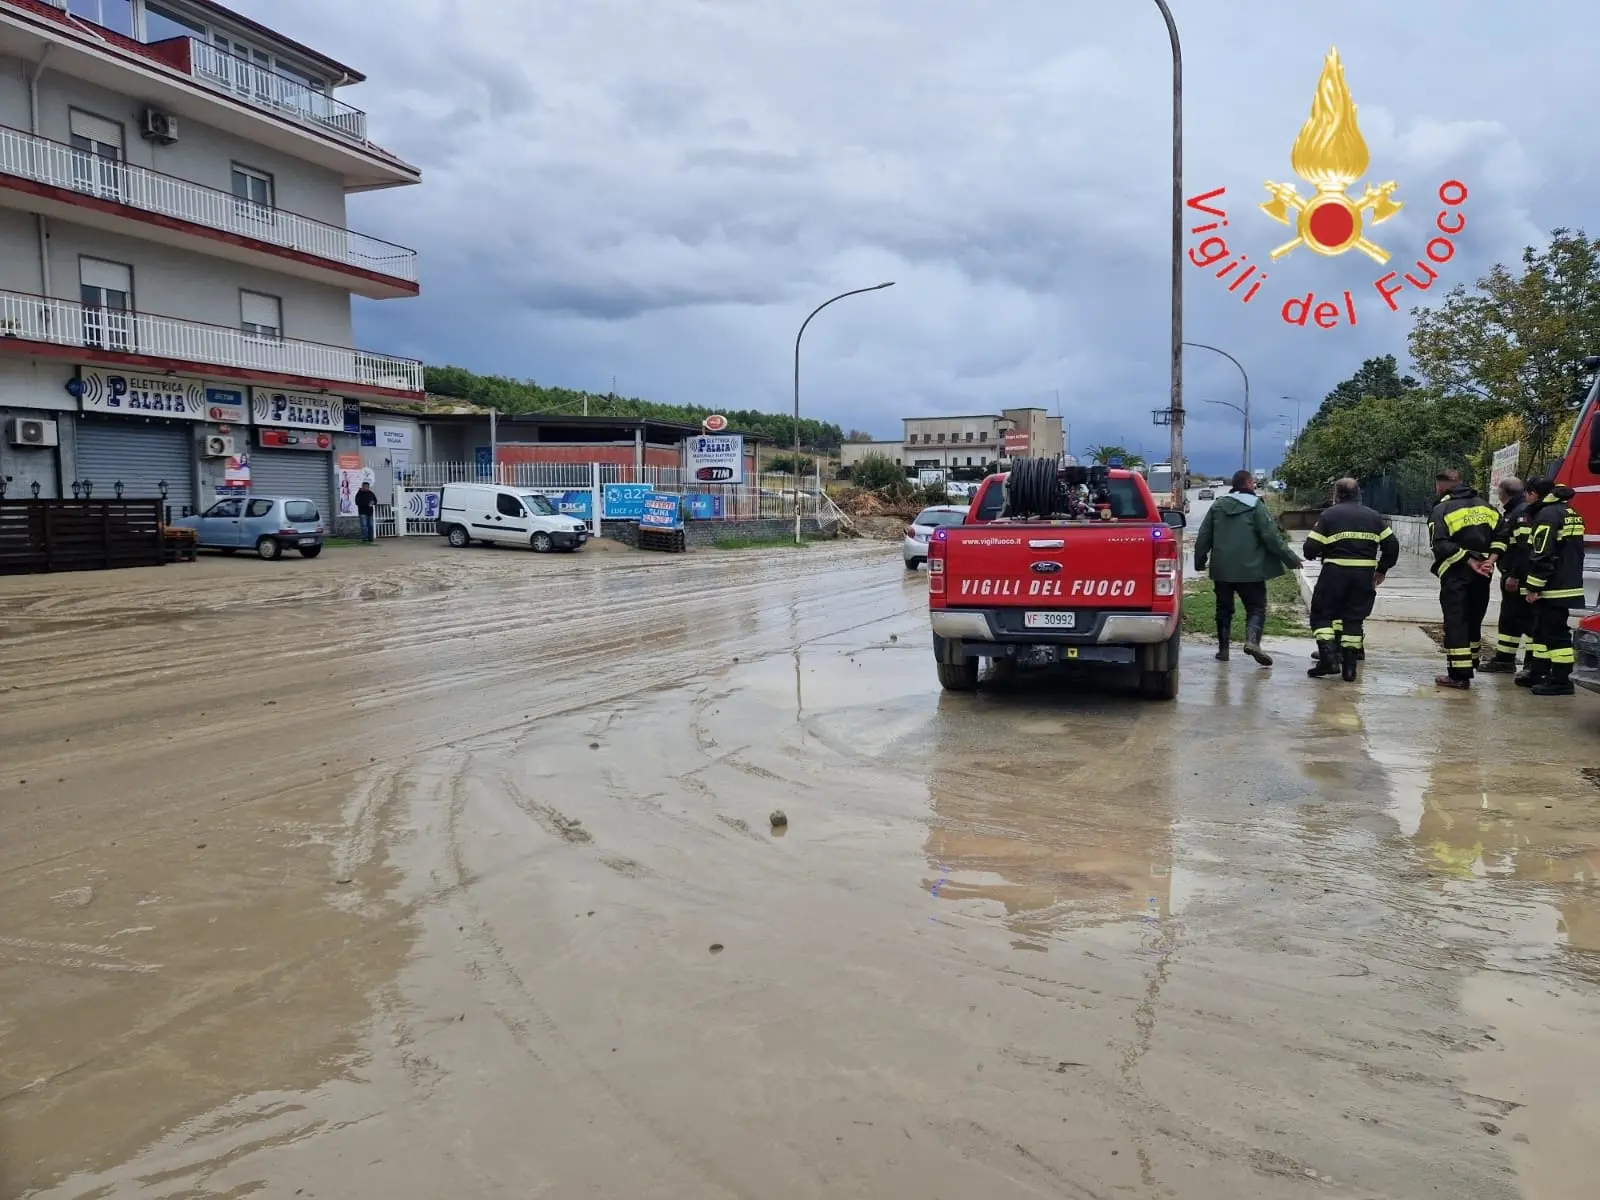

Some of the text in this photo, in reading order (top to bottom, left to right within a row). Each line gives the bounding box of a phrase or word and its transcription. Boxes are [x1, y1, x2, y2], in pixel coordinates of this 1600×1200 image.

[130, 378, 184, 392] ELETTRICA
[107, 375, 186, 413] PALAIA
[288, 395, 329, 407] ELETTRICA
[271, 393, 330, 425] PALAIA
[697, 438, 731, 453] PALAIA
[712, 469, 731, 479] TIM
[962, 537, 1021, 546] www.vigilfuoco.it
[1036, 562, 1056, 571] Ford
[961, 579, 1136, 596] VIGILI DEL FUOCO
[1027, 614, 1073, 625] VF 30992
